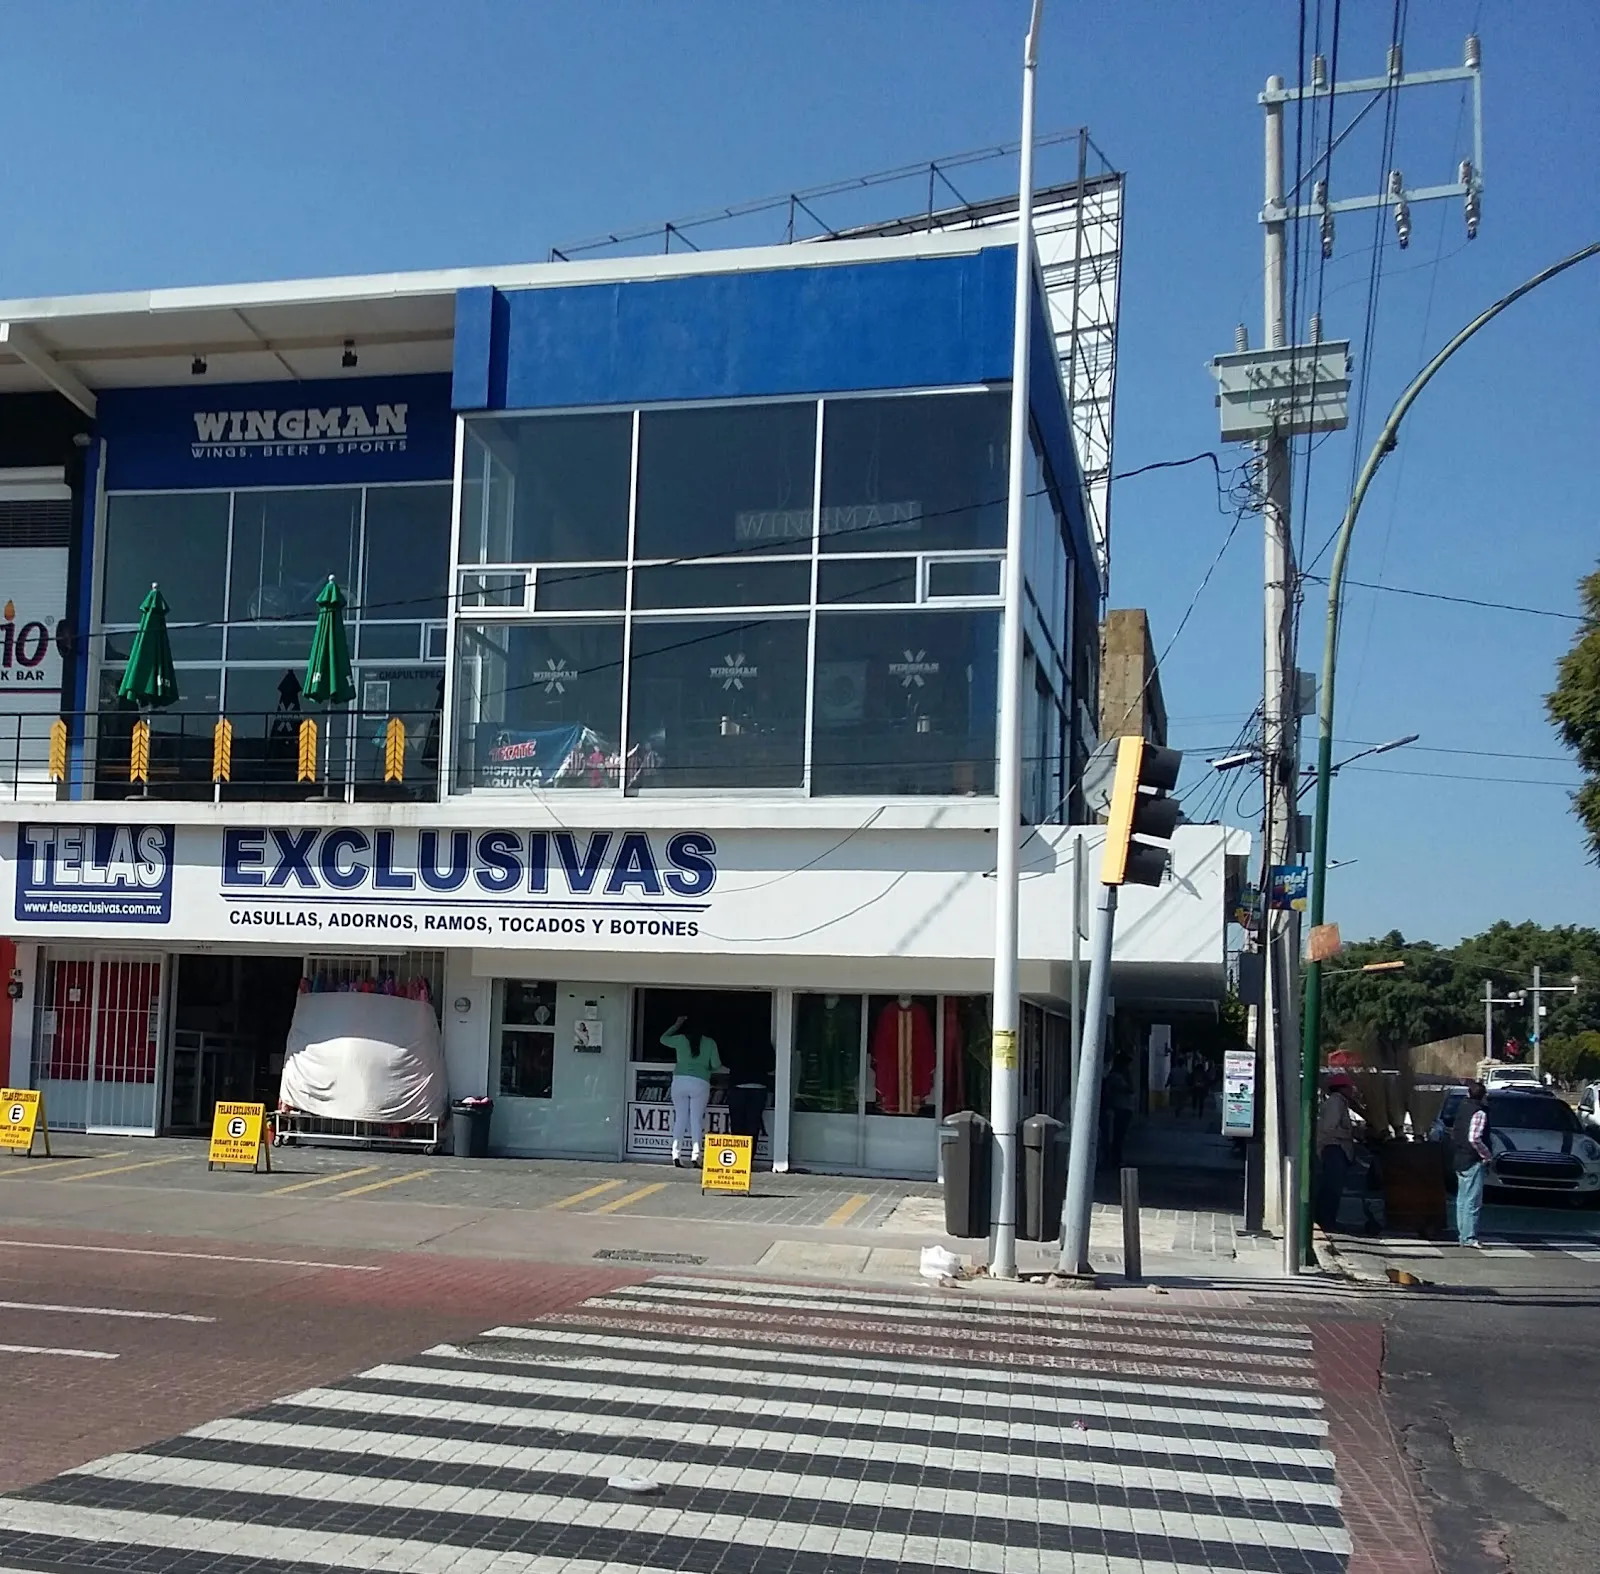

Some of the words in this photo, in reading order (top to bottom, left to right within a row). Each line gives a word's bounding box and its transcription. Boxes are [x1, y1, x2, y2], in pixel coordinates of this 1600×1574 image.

[194, 404, 408, 441] WINGMAN
[263, 446, 308, 457] BEER
[337, 441, 407, 453] SPORTS
[16, 671, 44, 681] BAR
[533, 671, 577, 679] WINGMAN
[710, 667, 757, 676] WINGMAN
[489, 740, 537, 761] TECATE
[482, 765, 543, 777] DISFRUTA
[26, 826, 167, 888] TELAS
[221, 827, 717, 897] EXCLUSIVAS
[24, 901, 162, 915] www.telasexclusivas.com.mx
[229, 911, 323, 930] CASULLAS,
[328, 913, 418, 932] ADORNOS,
[424, 915, 493, 934] RAMOS,
[499, 917, 585, 933] TOCADOS
[592, 919, 604, 934] Y
[610, 920, 699, 936] BOTONES
[12, 1107, 21, 1120] E
[218, 1104, 232, 1115] TELAS
[233, 1105, 261, 1116] EXCLUSIVAS
[232, 1120, 243, 1134] E
[708, 1137, 722, 1147] TELAS
[723, 1138, 749, 1148] EXCLUSIVAS
[723, 1152, 732, 1164] E
